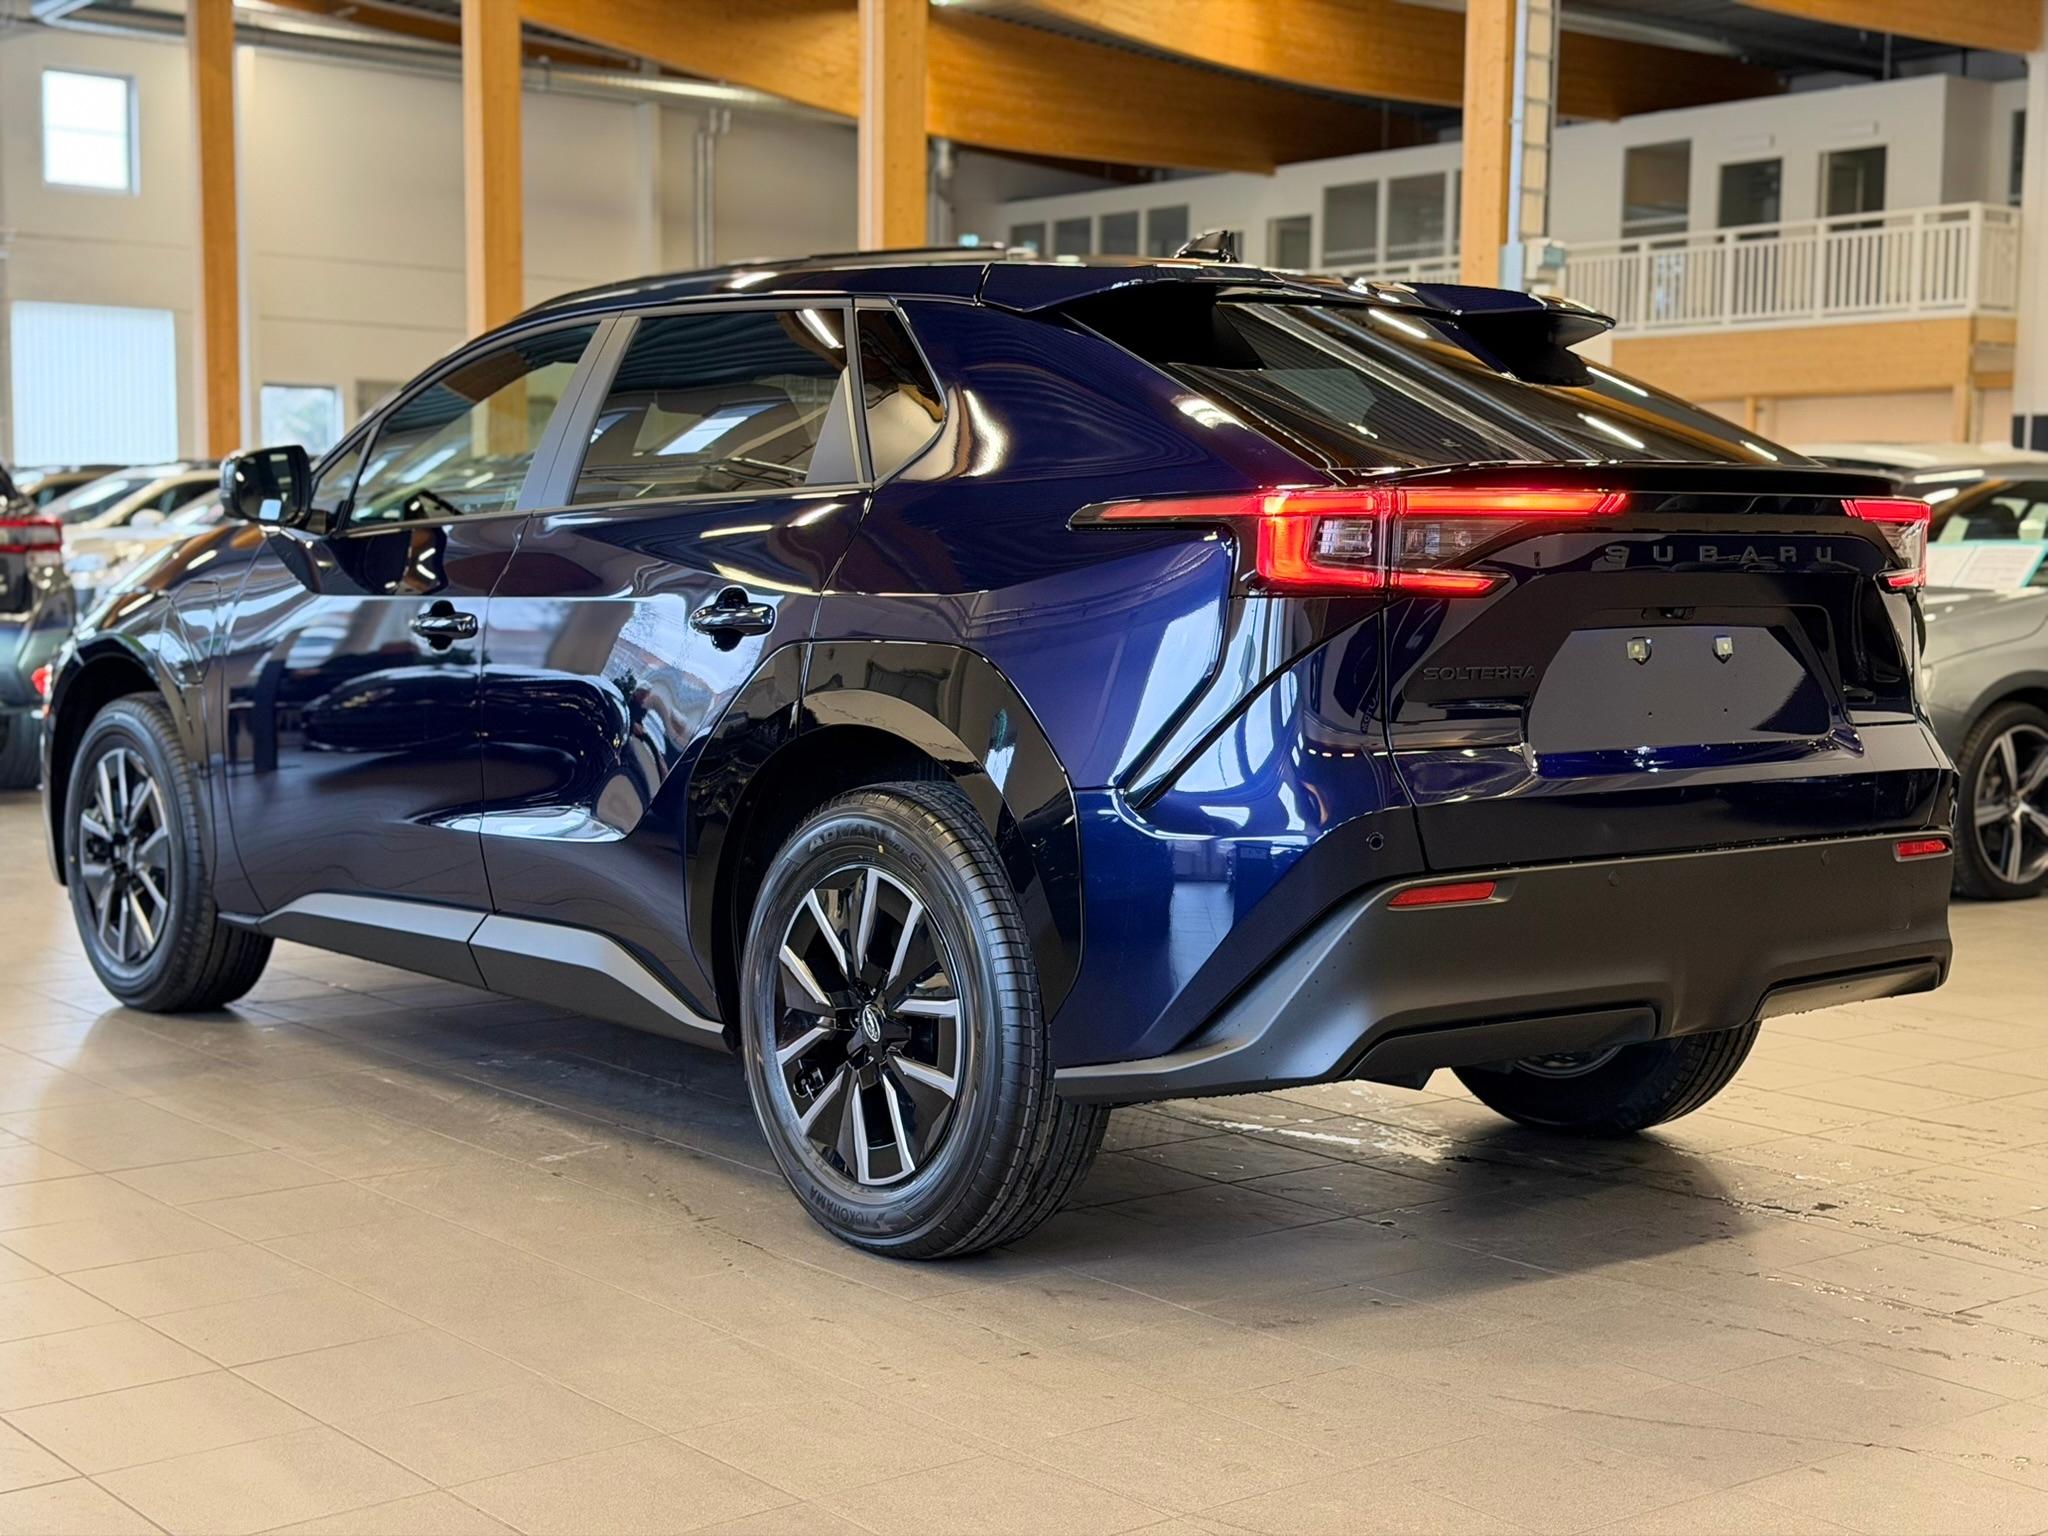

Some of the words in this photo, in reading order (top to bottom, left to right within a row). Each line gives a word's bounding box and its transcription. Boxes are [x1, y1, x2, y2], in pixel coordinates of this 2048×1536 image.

[1604, 545, 1833, 564] SUBARU
[1423, 665, 1536, 681] SOLTERRA
[808, 823, 887, 853] ADVAN
[810, 1185, 871, 1224] YOKOHAMA
